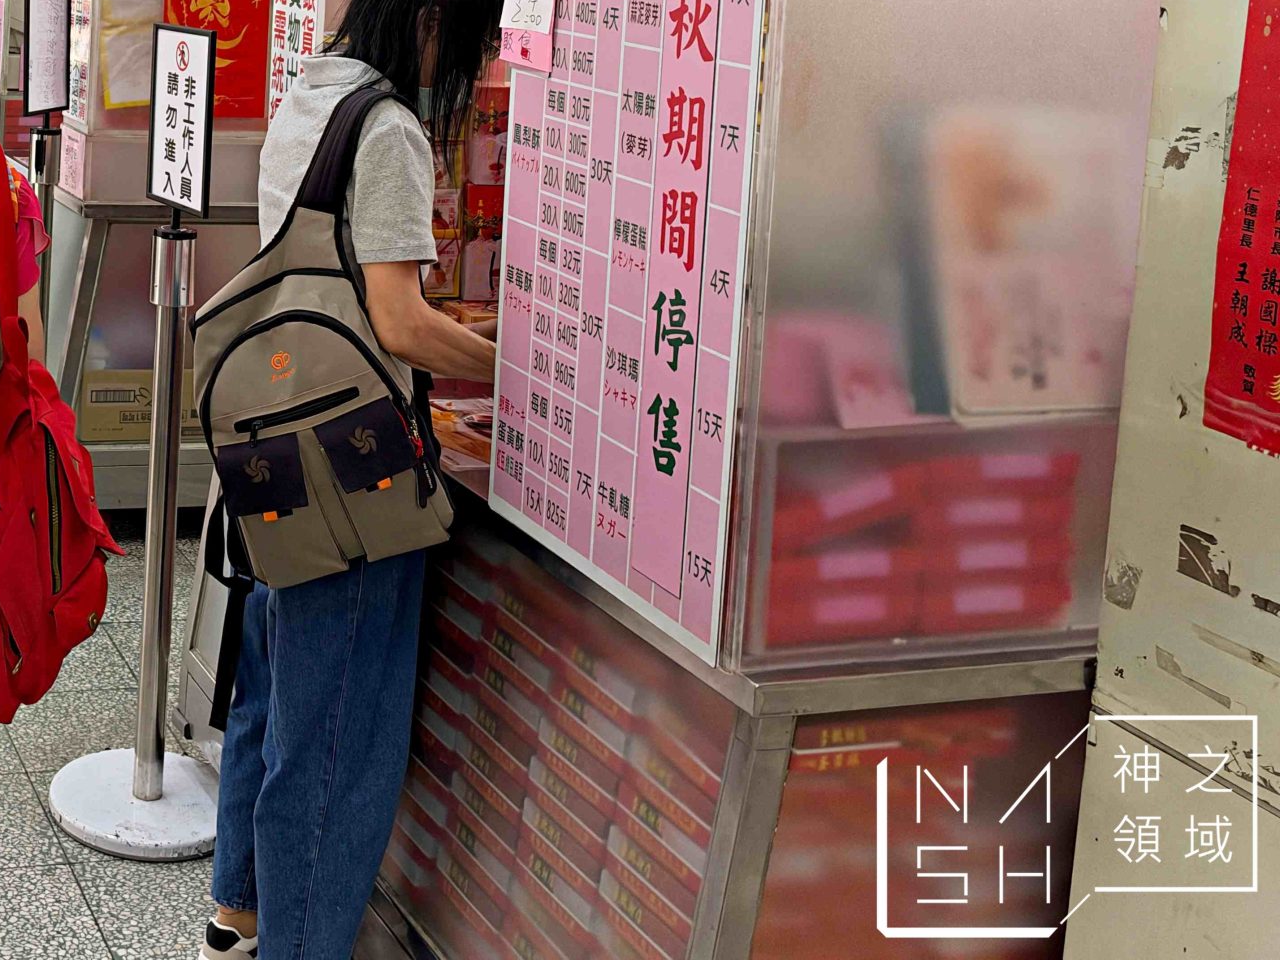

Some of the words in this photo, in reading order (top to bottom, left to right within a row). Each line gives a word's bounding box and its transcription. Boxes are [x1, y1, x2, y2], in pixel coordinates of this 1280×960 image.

[557, 0, 572, 23] 0入
[575, 0, 597, 26] 480元
[602, 5, 621, 33] 4天
[572, 50, 594, 76] 960元
[547, 89, 566, 114] 每個
[571, 96, 590, 123] 30元
[621, 88, 656, 119] 太陽餅
[162, 71, 180, 197] 請勿進入
[179, 74, 197, 203] 非工作人員
[513, 123, 541, 152] 鳳梨酥
[545, 126, 563, 152] 10入
[568, 132, 588, 159] 300元
[620, 131, 654, 162] (麥芽)
[720, 124, 739, 154] 7天
[543, 164, 561, 190] 20入
[564, 171, 586, 198] 600元
[589, 160, 613, 186] 30天
[541, 202, 559, 228] 30入
[562, 212, 584, 238] 900元
[1239, 187, 1261, 249] 仁德里長
[538, 238, 557, 265] 每個
[562, 248, 581, 276] 32元
[506, 263, 533, 294] 草莓酥
[538, 274, 554, 300] 10入
[710, 269, 730, 299] 4天
[558, 281, 580, 312] 320元
[1228, 262, 1251, 349] 王朝成
[535, 311, 552, 337] 20入
[556, 320, 578, 351] 640元
[581, 311, 604, 343] 30天
[533, 348, 551, 379] 30入
[554, 360, 576, 391] 960元
[604, 344, 640, 383] 沙琪瑪
[531, 392, 549, 420] 每個
[603, 379, 637, 410] シャキマ
[553, 405, 573, 435] 55元
[696, 407, 723, 443] 15天
[528, 438, 545, 468] 10入
[548, 452, 570, 484] 550元
[576, 469, 593, 500] 7天
[525, 486, 543, 516] 15入
[545, 498, 566, 531] 825元
[597, 480, 631, 521] 牛軋糖
[596, 512, 627, 540] ヌガー
[686, 550, 713, 588] 15天
